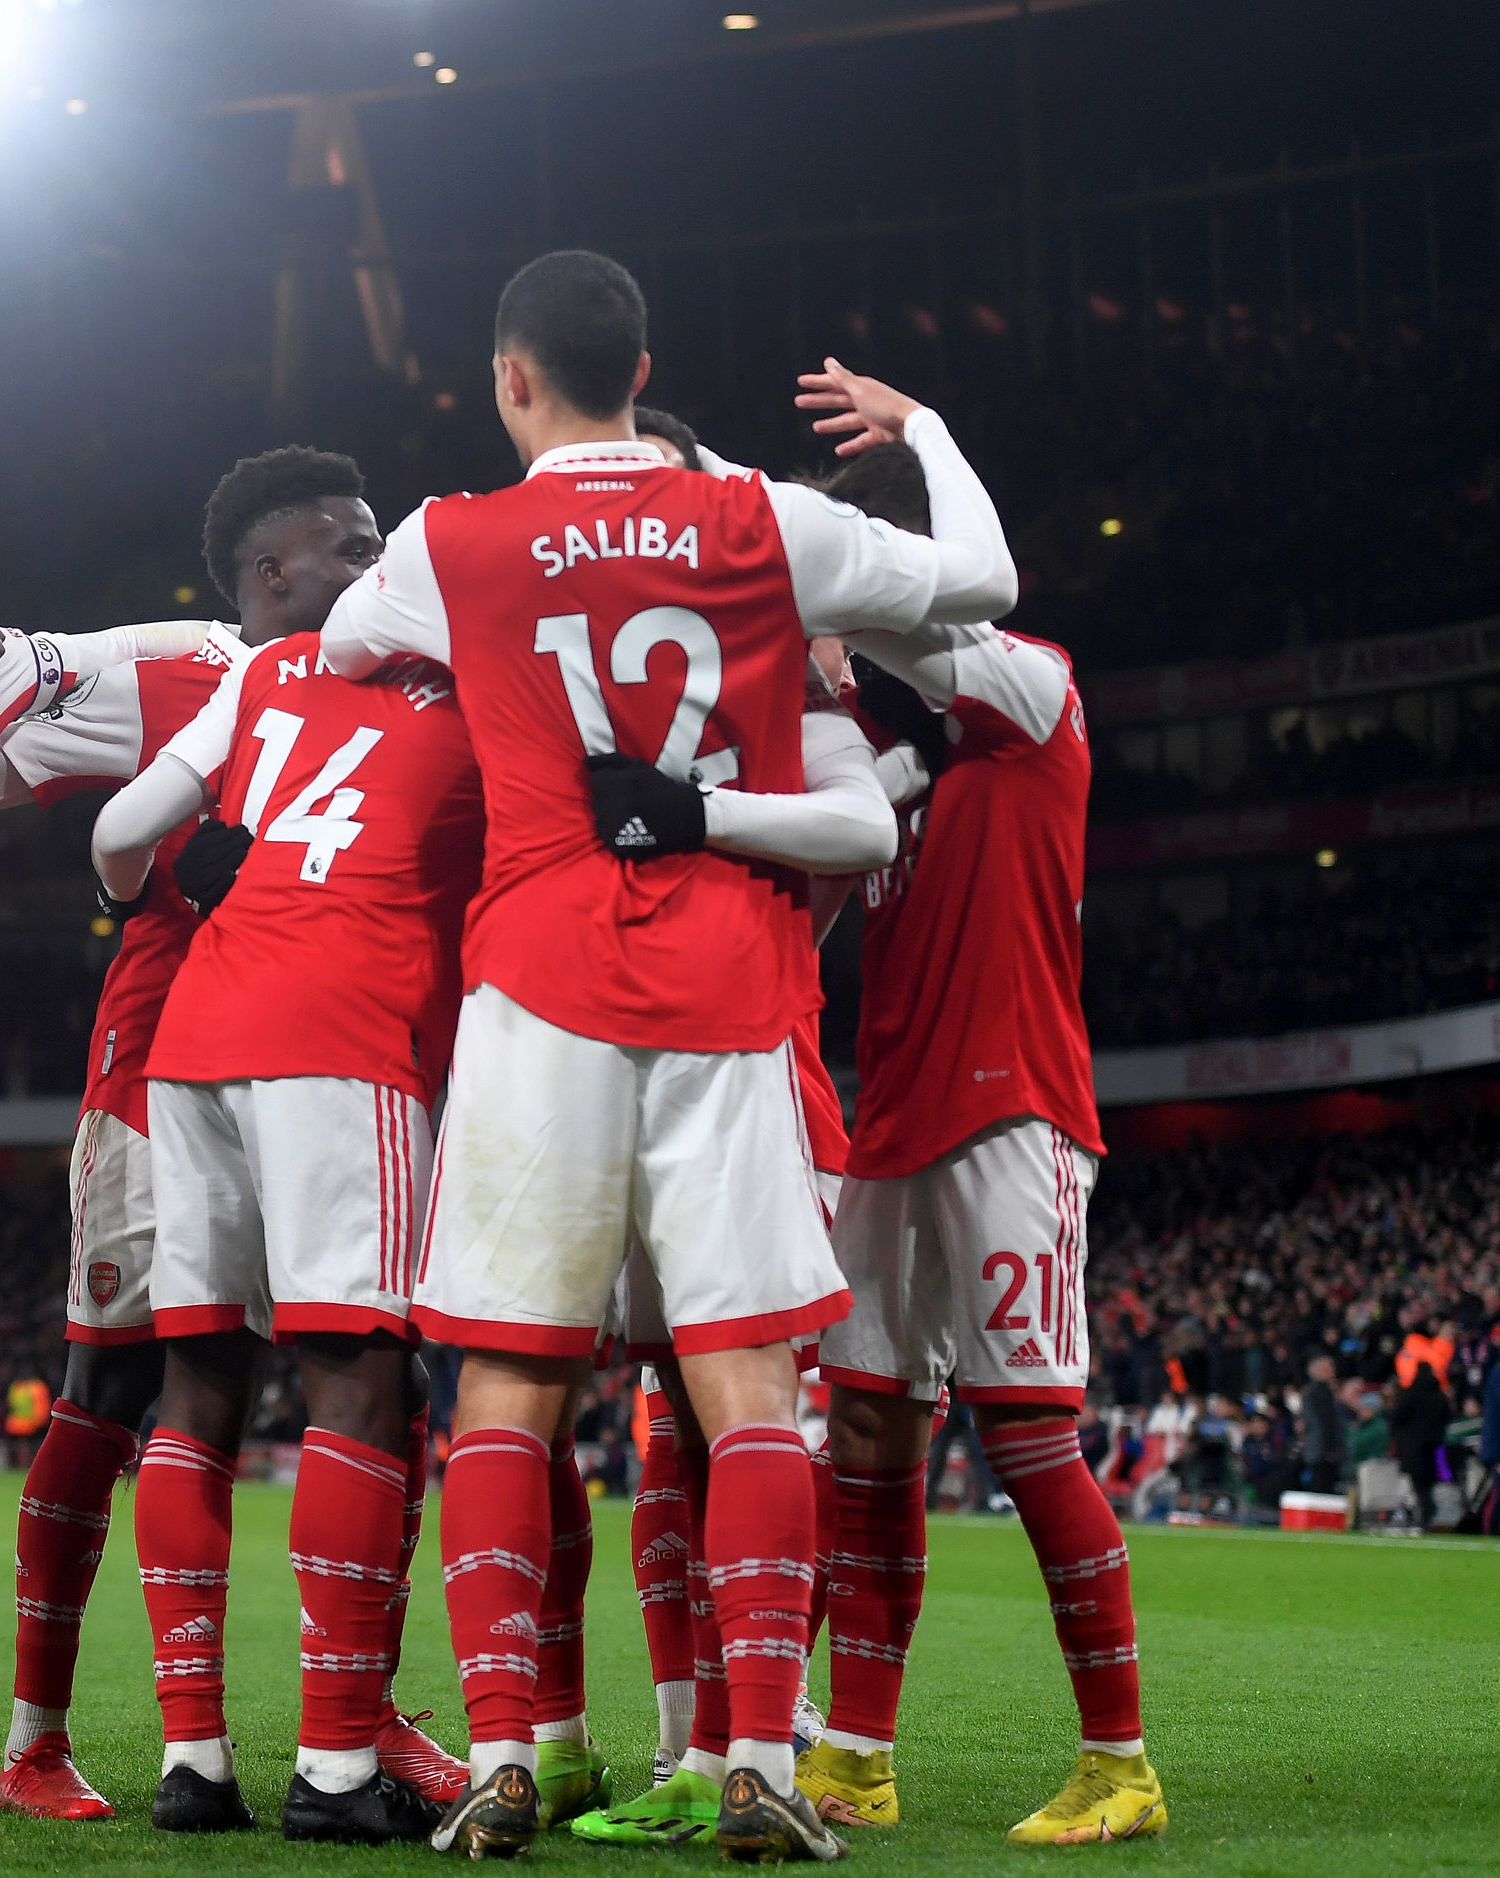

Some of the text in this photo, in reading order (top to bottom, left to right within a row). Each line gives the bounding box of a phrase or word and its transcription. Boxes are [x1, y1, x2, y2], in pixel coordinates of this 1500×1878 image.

[575, 480, 636, 492] ARSENAL
[531, 516, 699, 578] SALIBA
[534, 605, 741, 786] 12
[240, 707, 385, 884] 14
[92, 1269, 116, 1278] Arsenal
[982, 1250, 1053, 1333] 21
[1005, 1358, 1049, 1368] adidas
